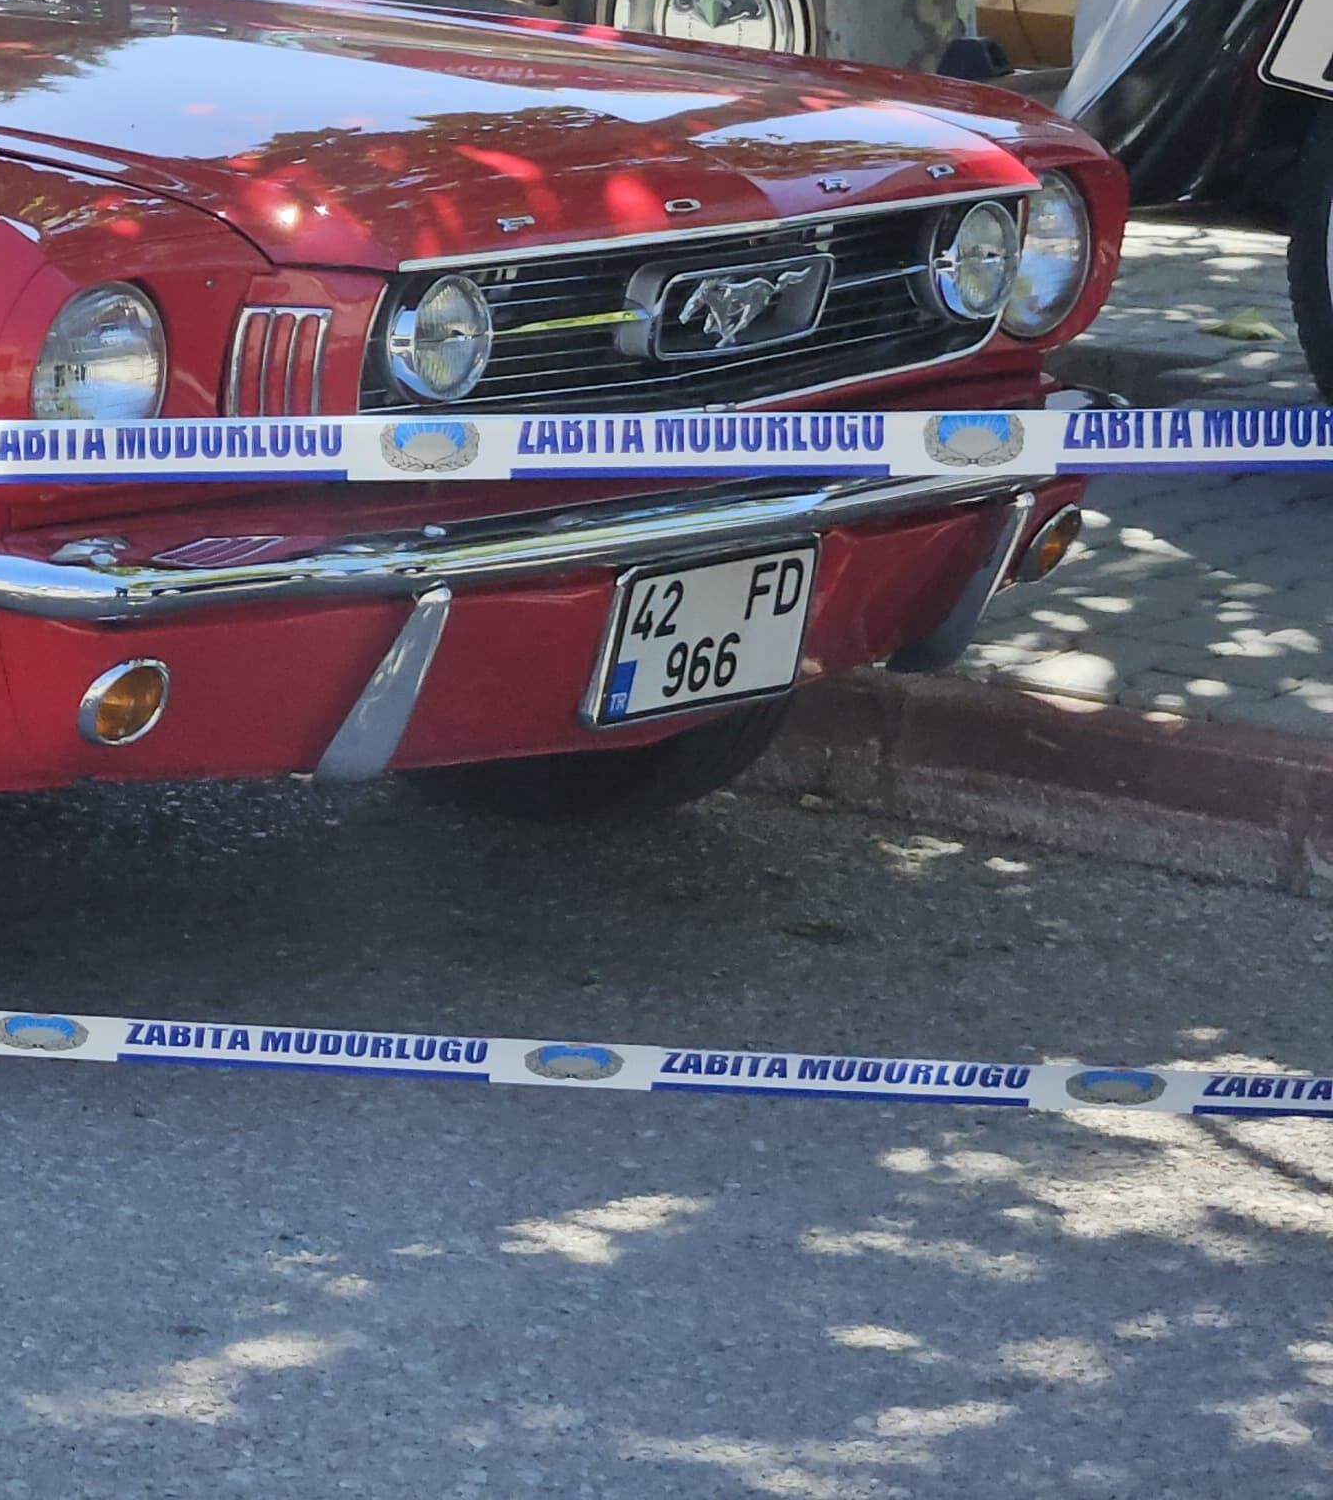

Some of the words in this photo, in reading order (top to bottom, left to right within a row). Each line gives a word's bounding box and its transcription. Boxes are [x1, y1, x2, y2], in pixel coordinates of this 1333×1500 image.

[1063, 411, 1192, 450] ZABITA
[631, 580, 684, 641] 42
[744, 557, 804, 620] FD
[662, 632, 741, 698] 966
[125, 1023, 250, 1050] ZABITA
[661, 1052, 788, 1079] ZABITA
[1202, 1075, 1333, 1101] ZABITA
